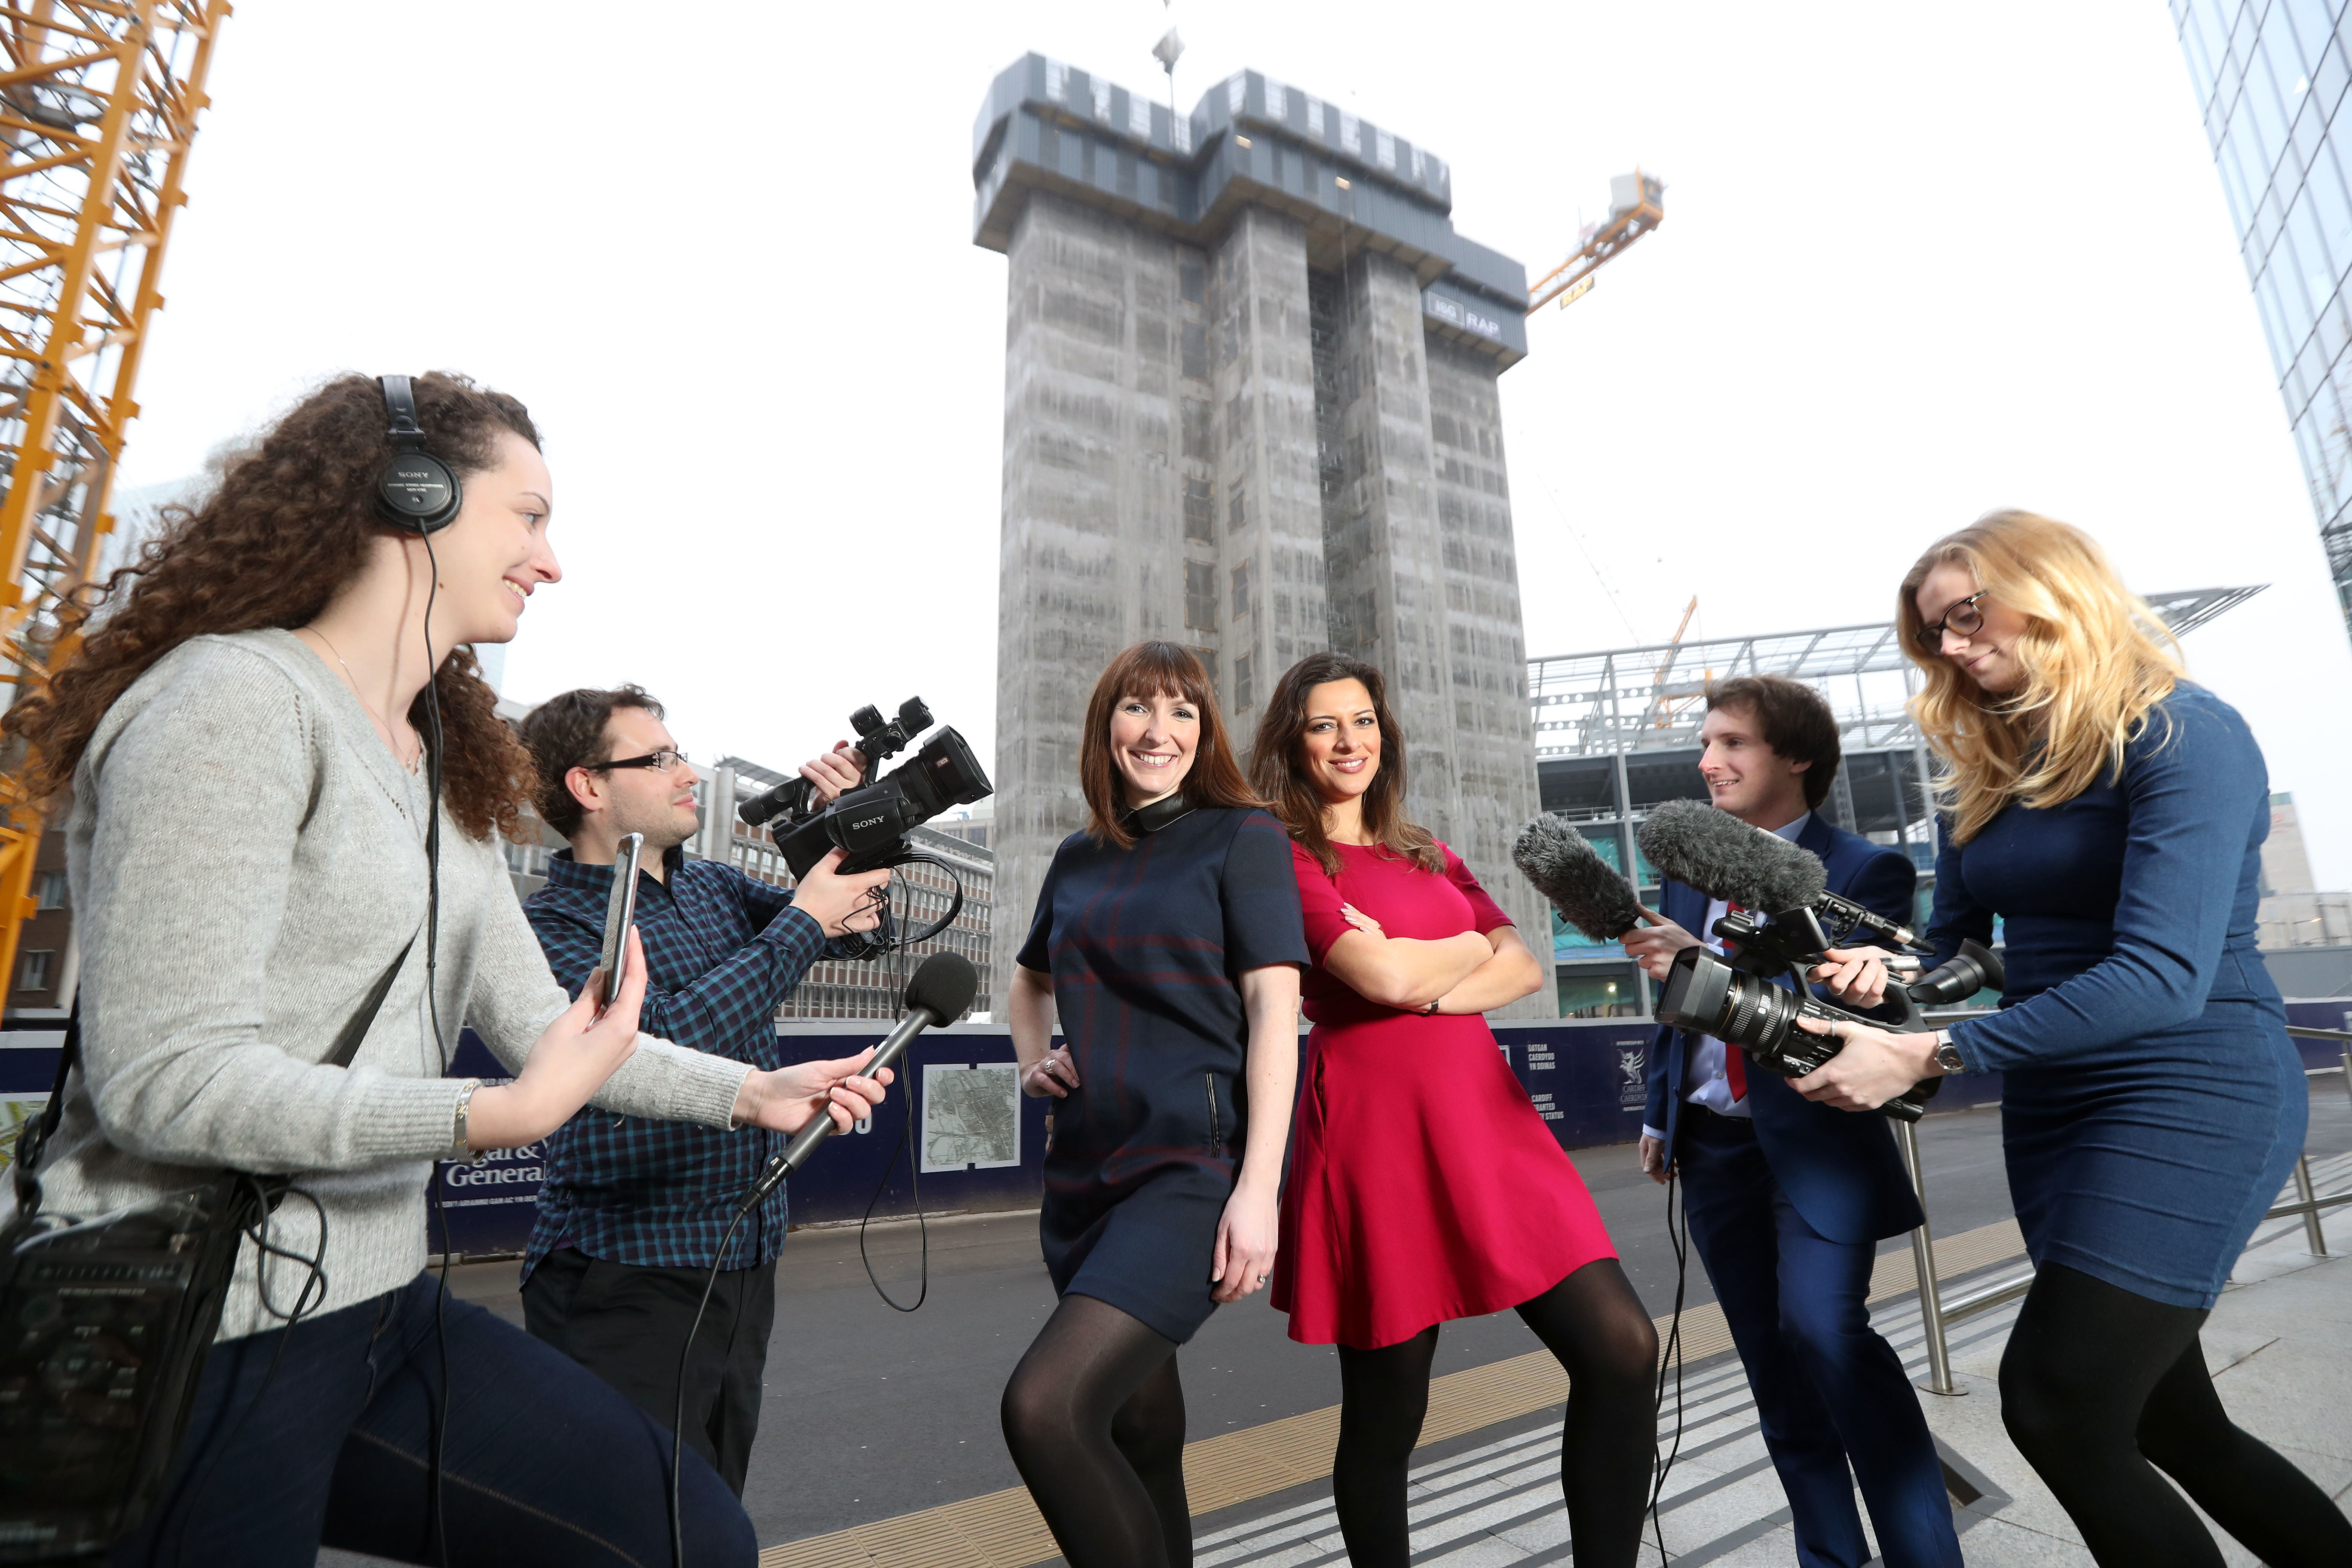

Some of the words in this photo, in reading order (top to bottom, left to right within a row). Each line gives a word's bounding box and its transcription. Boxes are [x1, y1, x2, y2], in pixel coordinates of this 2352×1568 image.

[1435, 300, 1457, 320] ISG
[1467, 312, 1499, 334] RAP
[852, 815, 884, 830] SONY
[1528, 1044, 1547, 1052] DATGAN
[1528, 1052, 1555, 1061] CAERDYDD
[1529, 1062, 1537, 1071] YN
[1623, 1084, 1646, 1092] CARDIFF
[1531, 1093, 1553, 1102] CARDIFF
[1545, 1111, 1565, 1120] STATUS
[515, 1146, 541, 1159] &
[445, 1160, 547, 1187] General
